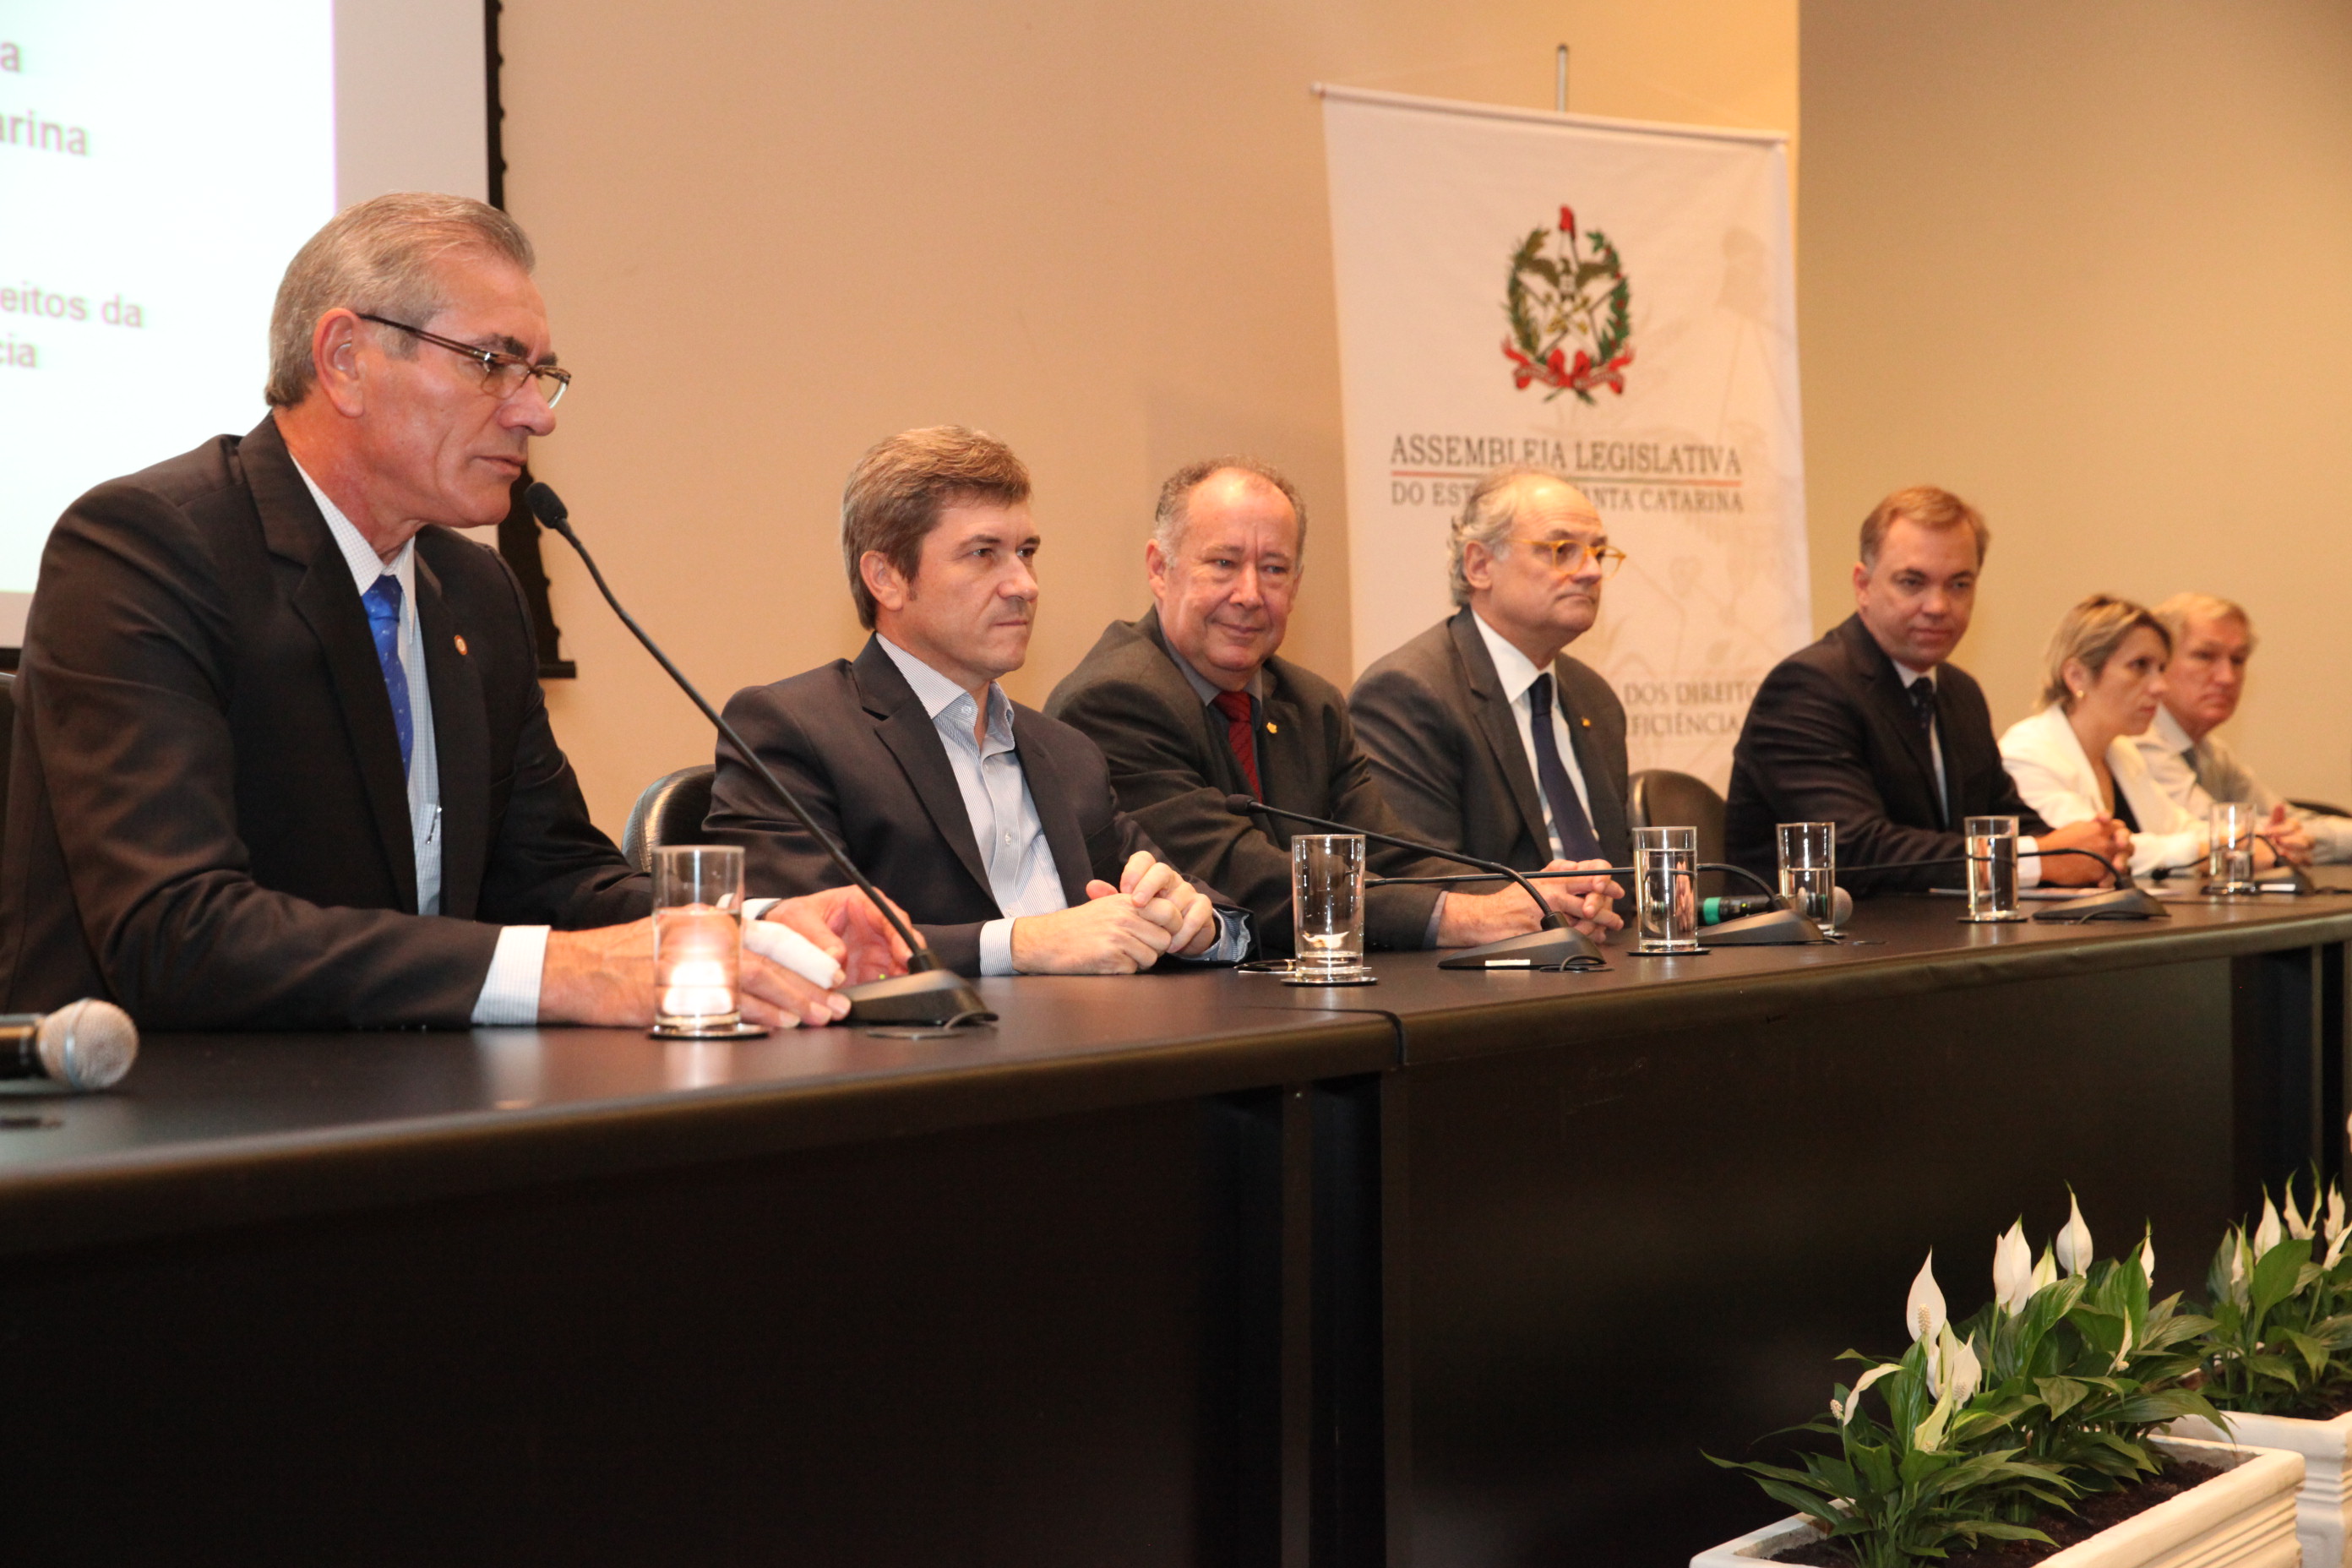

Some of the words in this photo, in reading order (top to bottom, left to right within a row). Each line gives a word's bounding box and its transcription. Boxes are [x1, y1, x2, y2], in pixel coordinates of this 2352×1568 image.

[0, 107, 88, 156] rina
[101, 294, 143, 329] da
[1390, 433, 1566, 469] ASSEMBLEIA
[1575, 439, 1742, 476] LEGISLATIVA
[1391, 480, 1425, 506] DO
[1638, 487, 1744, 514] CATARINA
[1623, 682, 1669, 706] DOS
